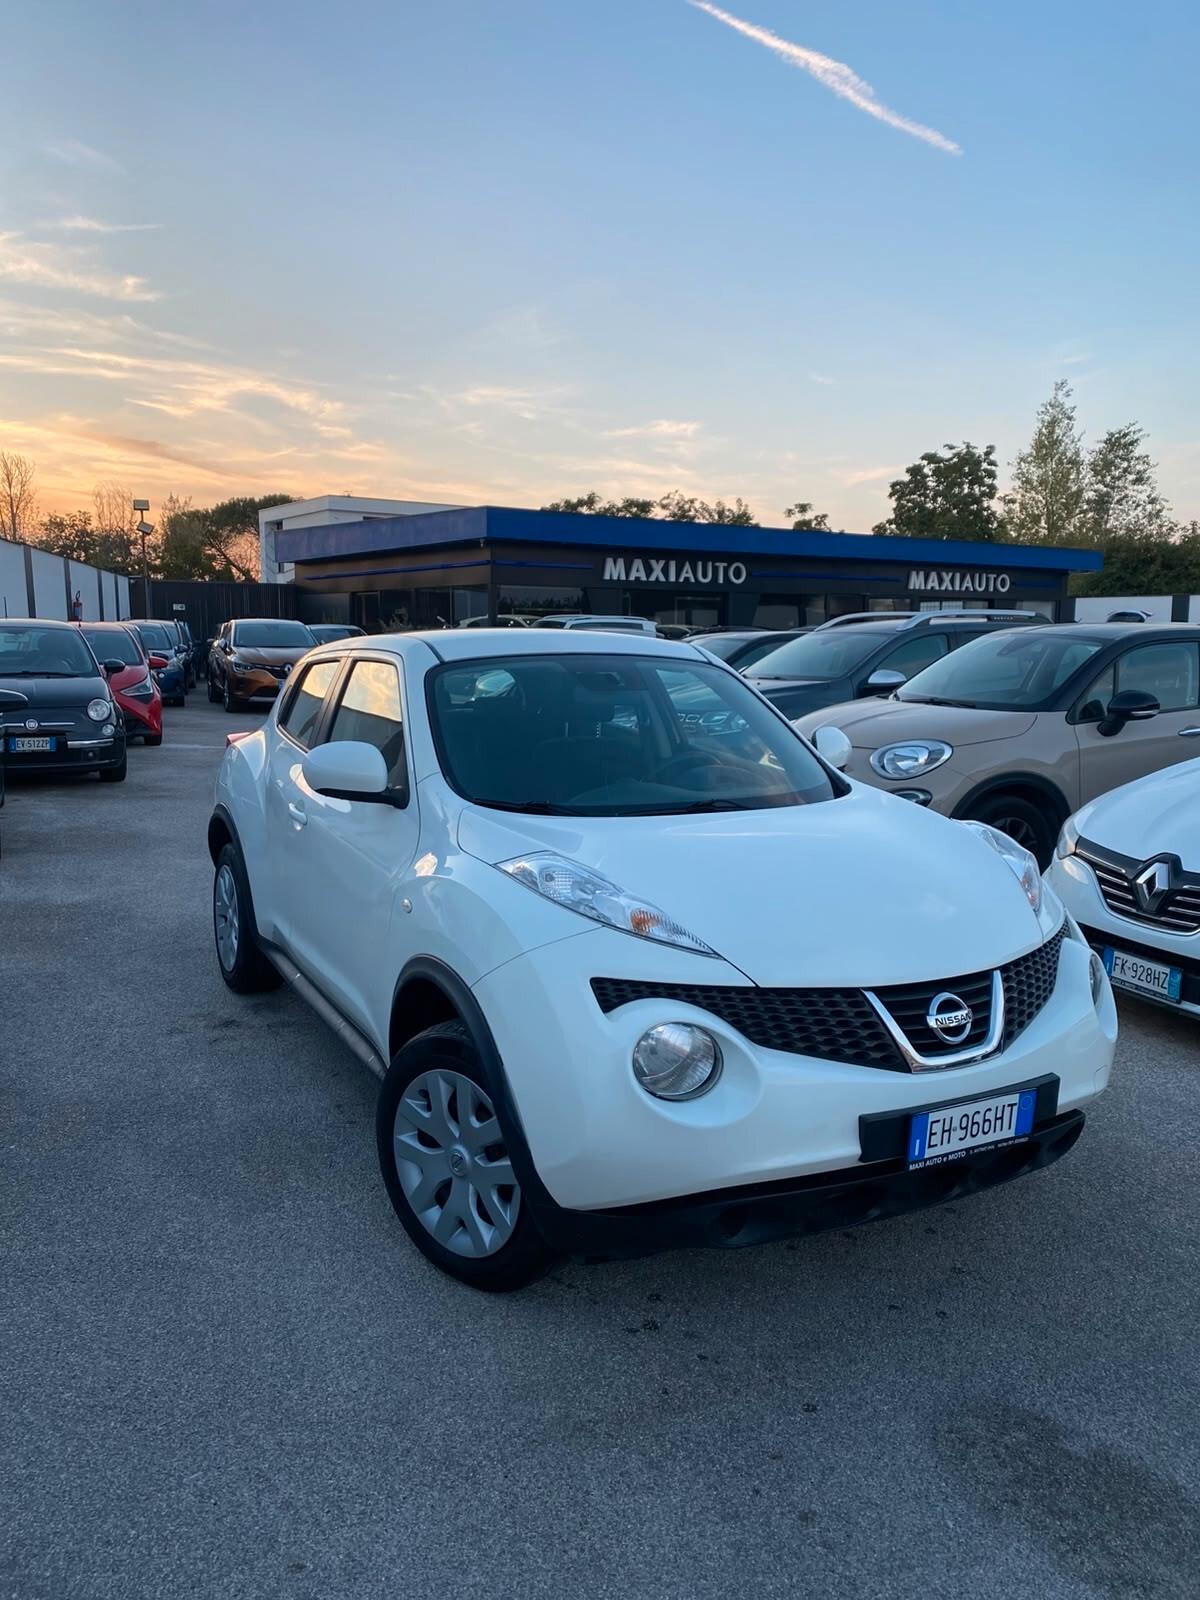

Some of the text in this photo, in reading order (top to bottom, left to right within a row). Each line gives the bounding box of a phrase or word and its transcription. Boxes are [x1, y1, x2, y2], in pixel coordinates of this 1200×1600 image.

[603, 556, 747, 584] MAXIAUTO
[908, 570, 1011, 592] MAXIAUTO
[935, 1012, 972, 1025] NISSAN
[909, 1161, 925, 1171] MAXI
[925, 1157, 942, 1167] AUTO
[948, 1150, 967, 1161] MOTO
